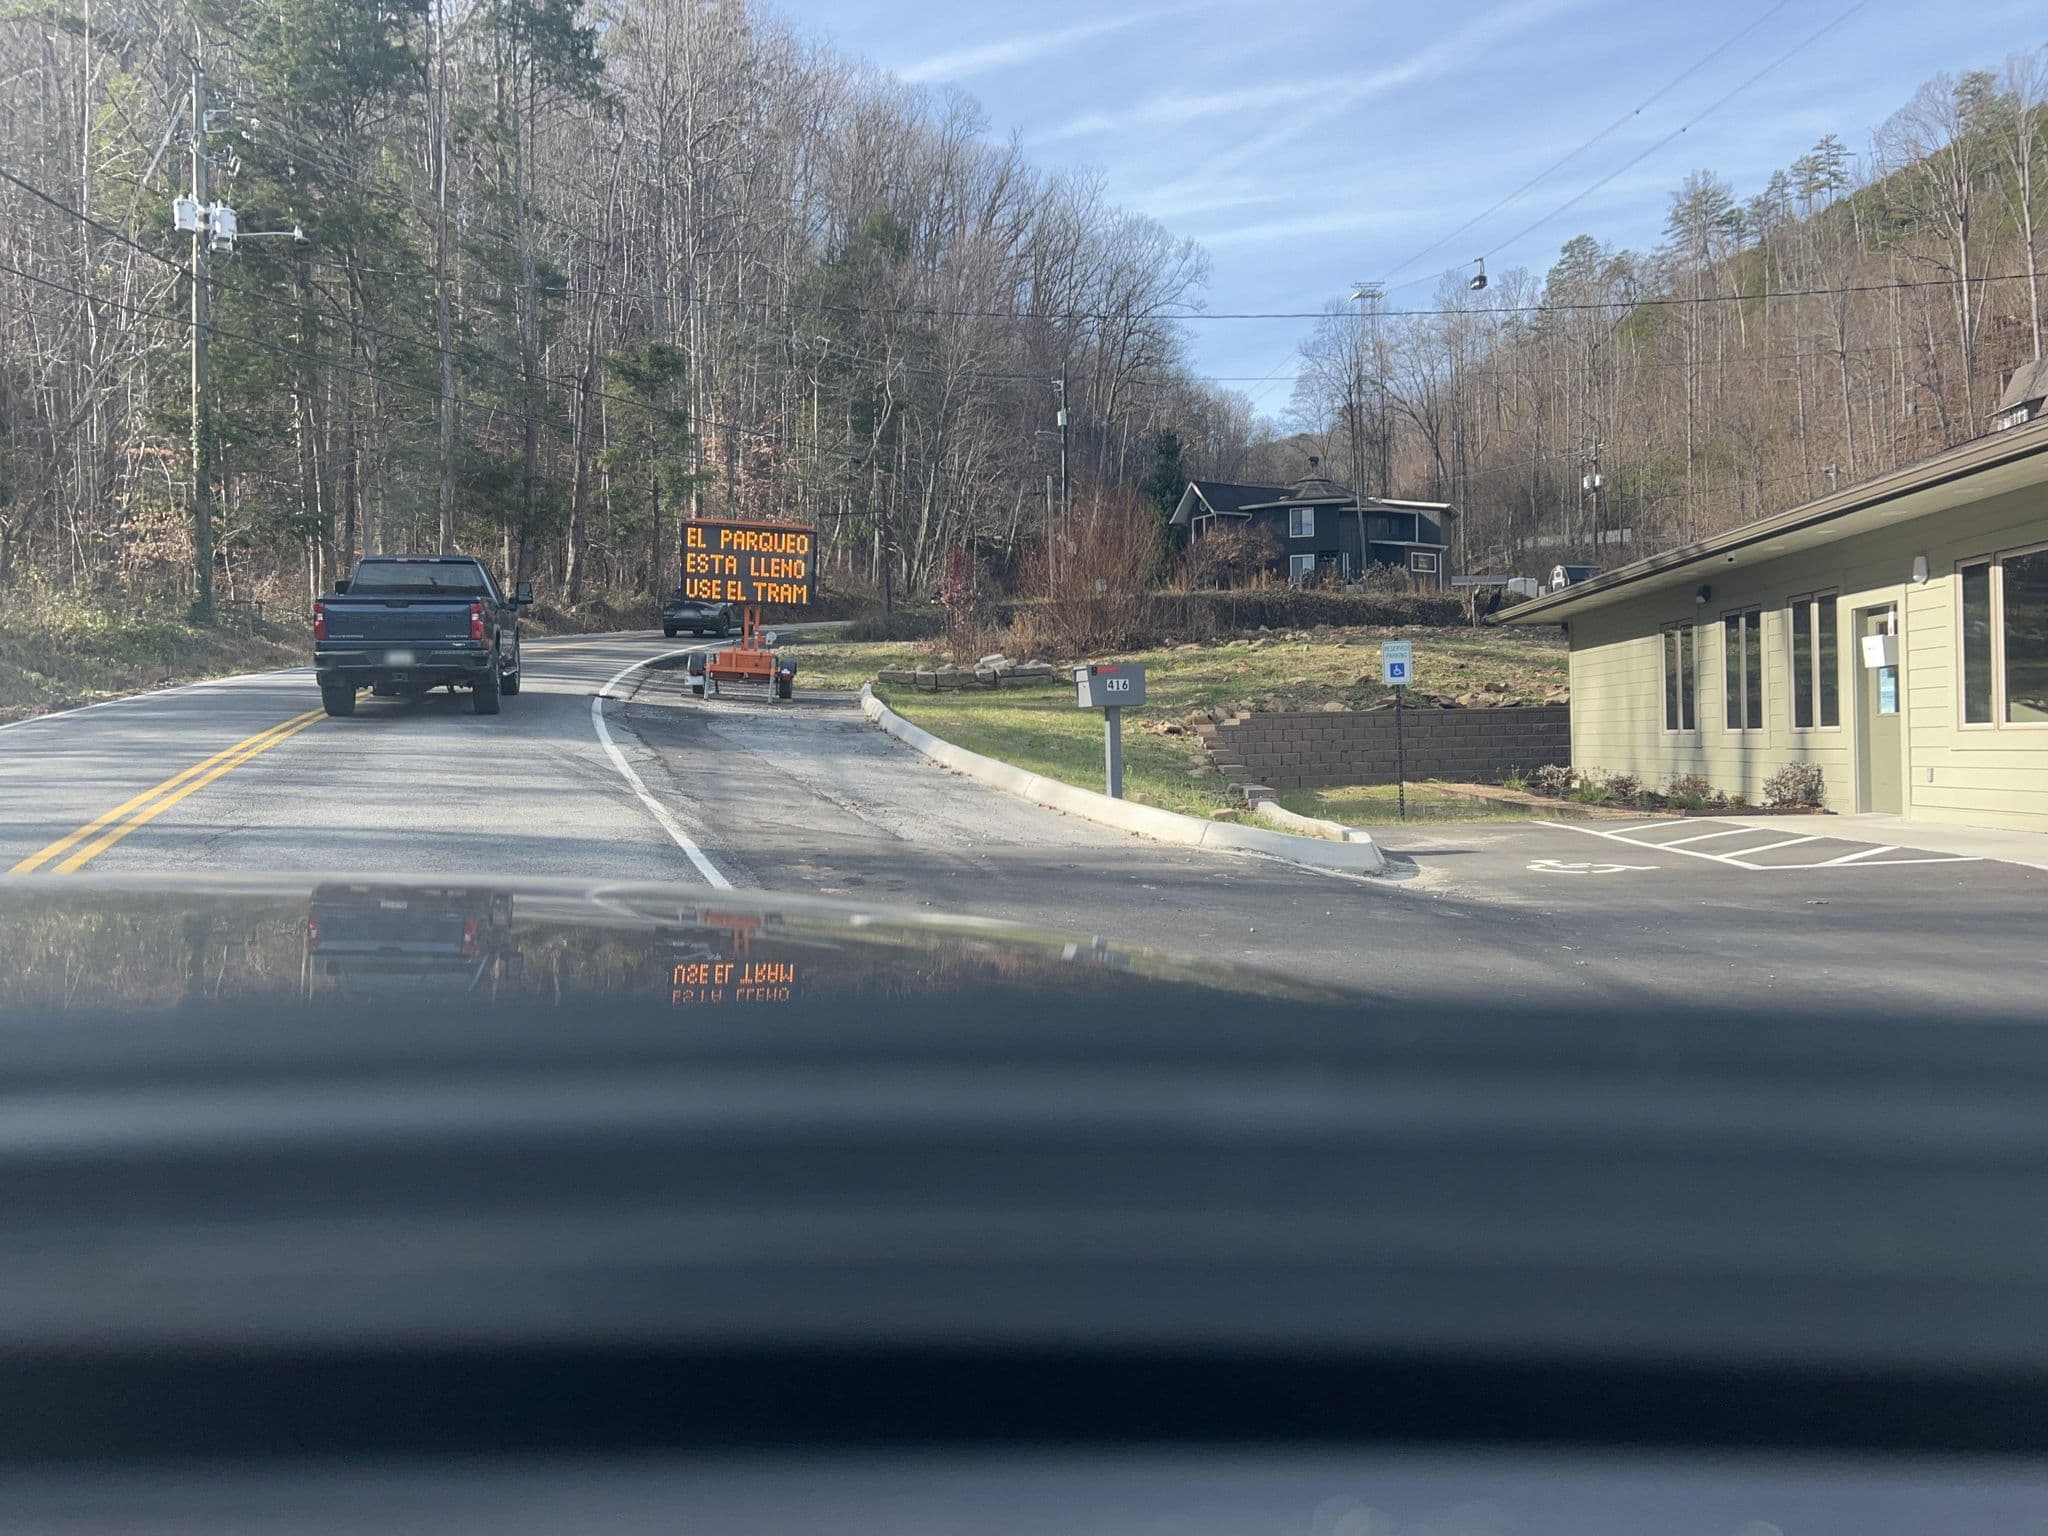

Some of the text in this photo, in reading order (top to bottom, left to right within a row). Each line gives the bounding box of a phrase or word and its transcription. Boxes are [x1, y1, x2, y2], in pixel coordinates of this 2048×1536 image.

[687, 527, 809, 554] EL PARQUEO
[686, 552, 806, 579] ESTA LLENO
[686, 578, 807, 604] USE EL TRAM
[1107, 680, 1128, 690] 416
